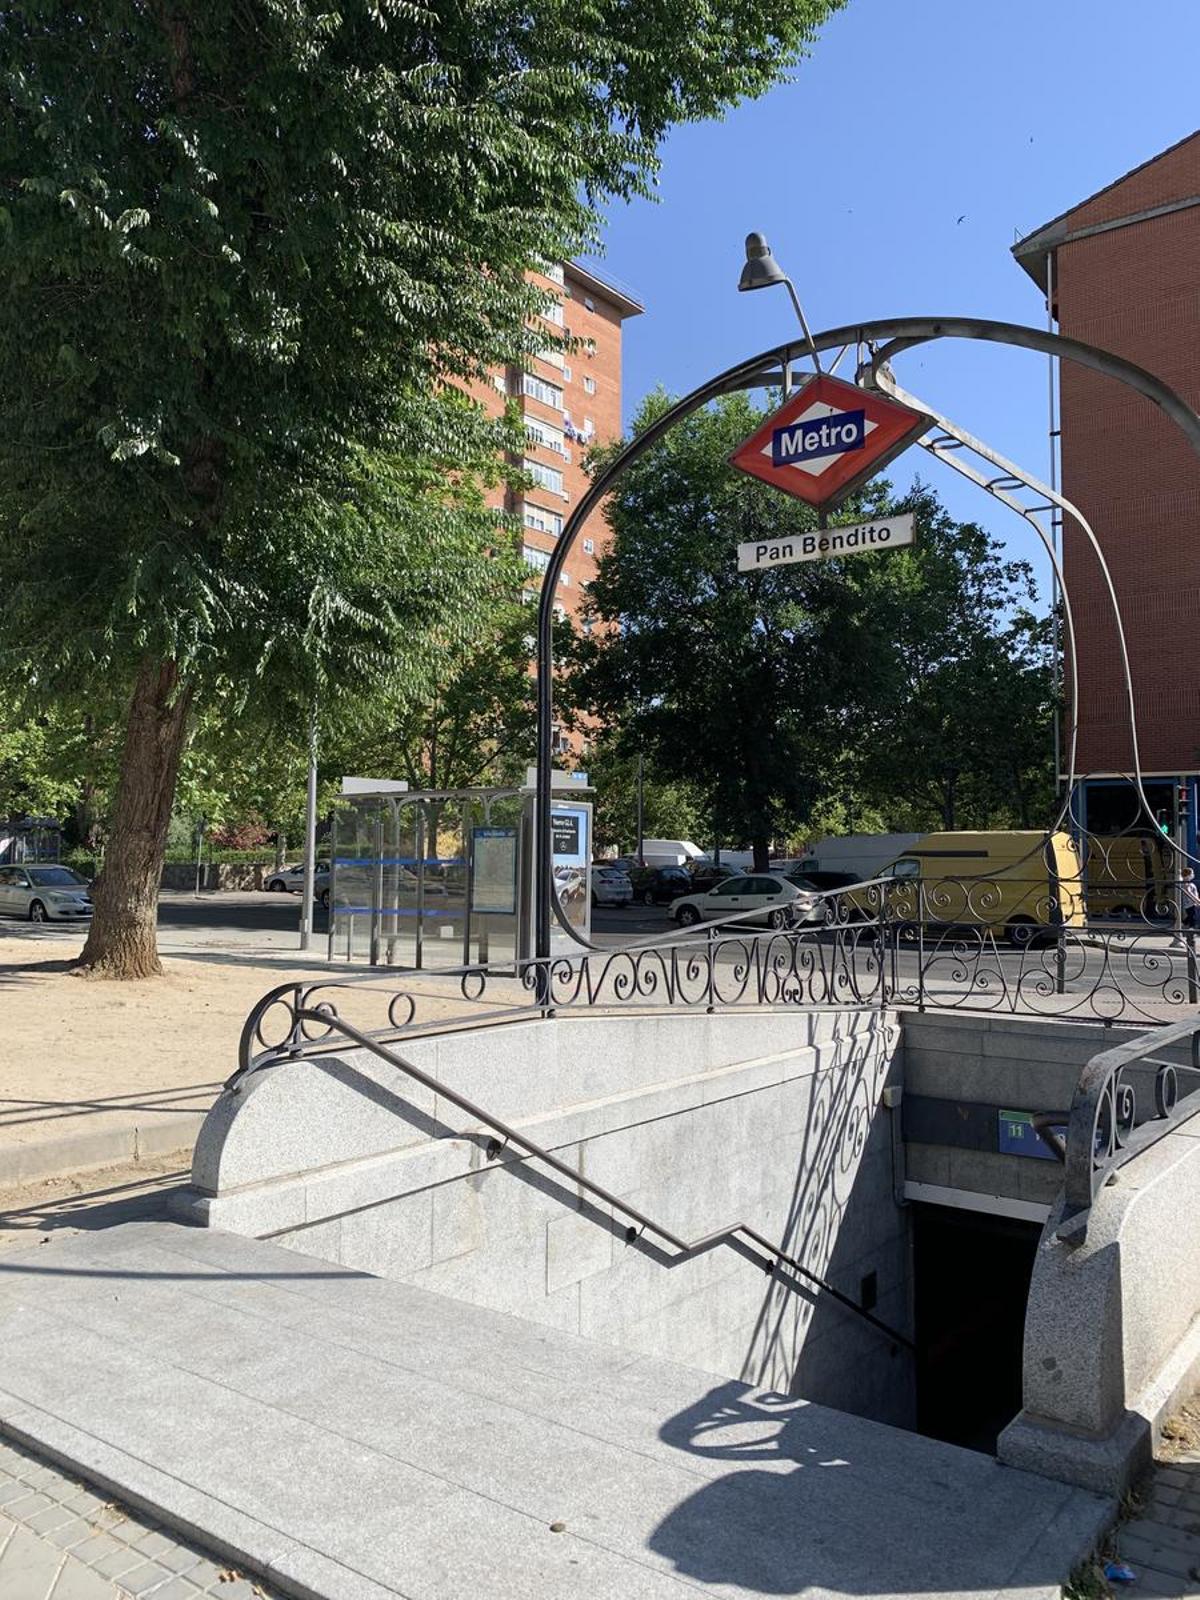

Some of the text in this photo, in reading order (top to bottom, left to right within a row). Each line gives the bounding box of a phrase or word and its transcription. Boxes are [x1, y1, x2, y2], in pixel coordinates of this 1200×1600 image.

[780, 423, 858, 457] Metro
[756, 526, 891, 563] Pan Bendito
[1009, 1124, 1023, 1137] 11
